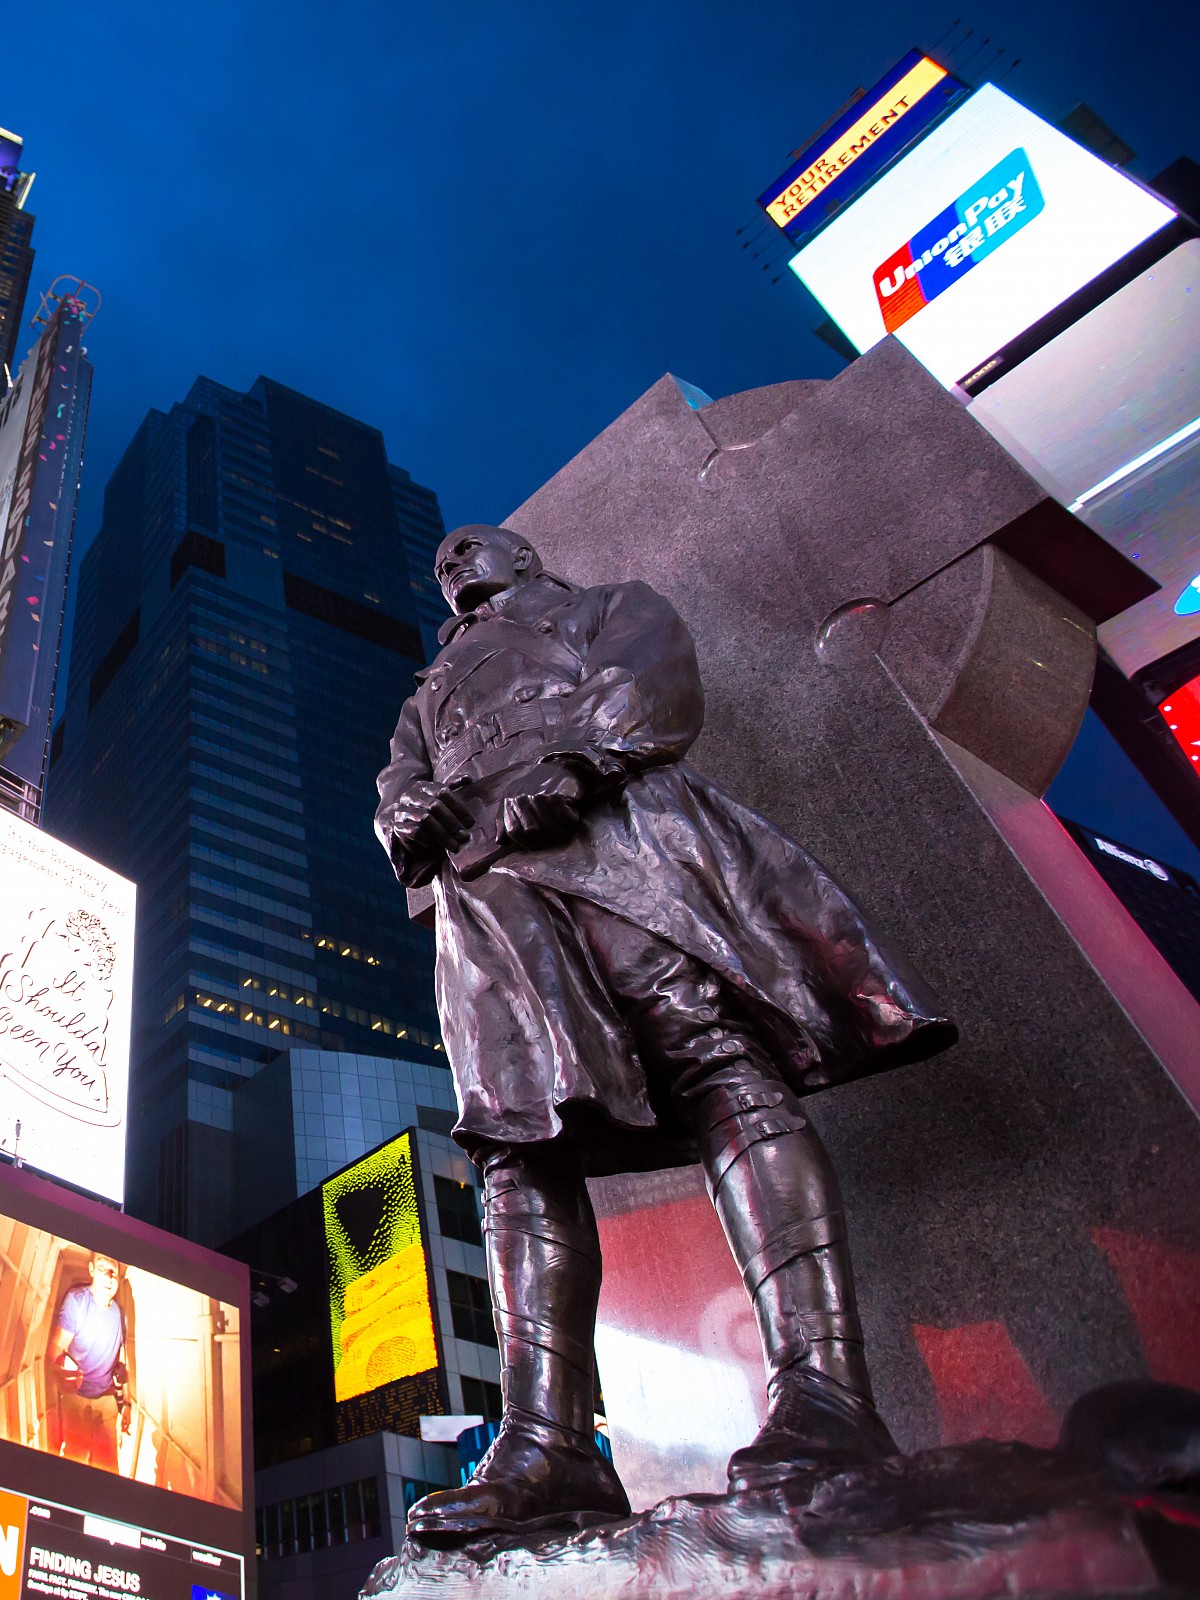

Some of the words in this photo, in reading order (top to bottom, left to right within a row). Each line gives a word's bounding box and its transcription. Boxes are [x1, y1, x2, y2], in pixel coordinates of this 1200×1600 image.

[776, 156, 830, 208] YOUR
[782, 95, 911, 218] RETIREMENT
[878, 171, 1026, 298] UnionPay
[943, 194, 1028, 270] 银联
[52, 970, 86, 1002] It
[5, 974, 107, 1067] Shoulda
[52, 1042, 97, 1092] You
[29, 1546, 92, 1580] FINDING
[93, 1564, 141, 1593] JESUS
